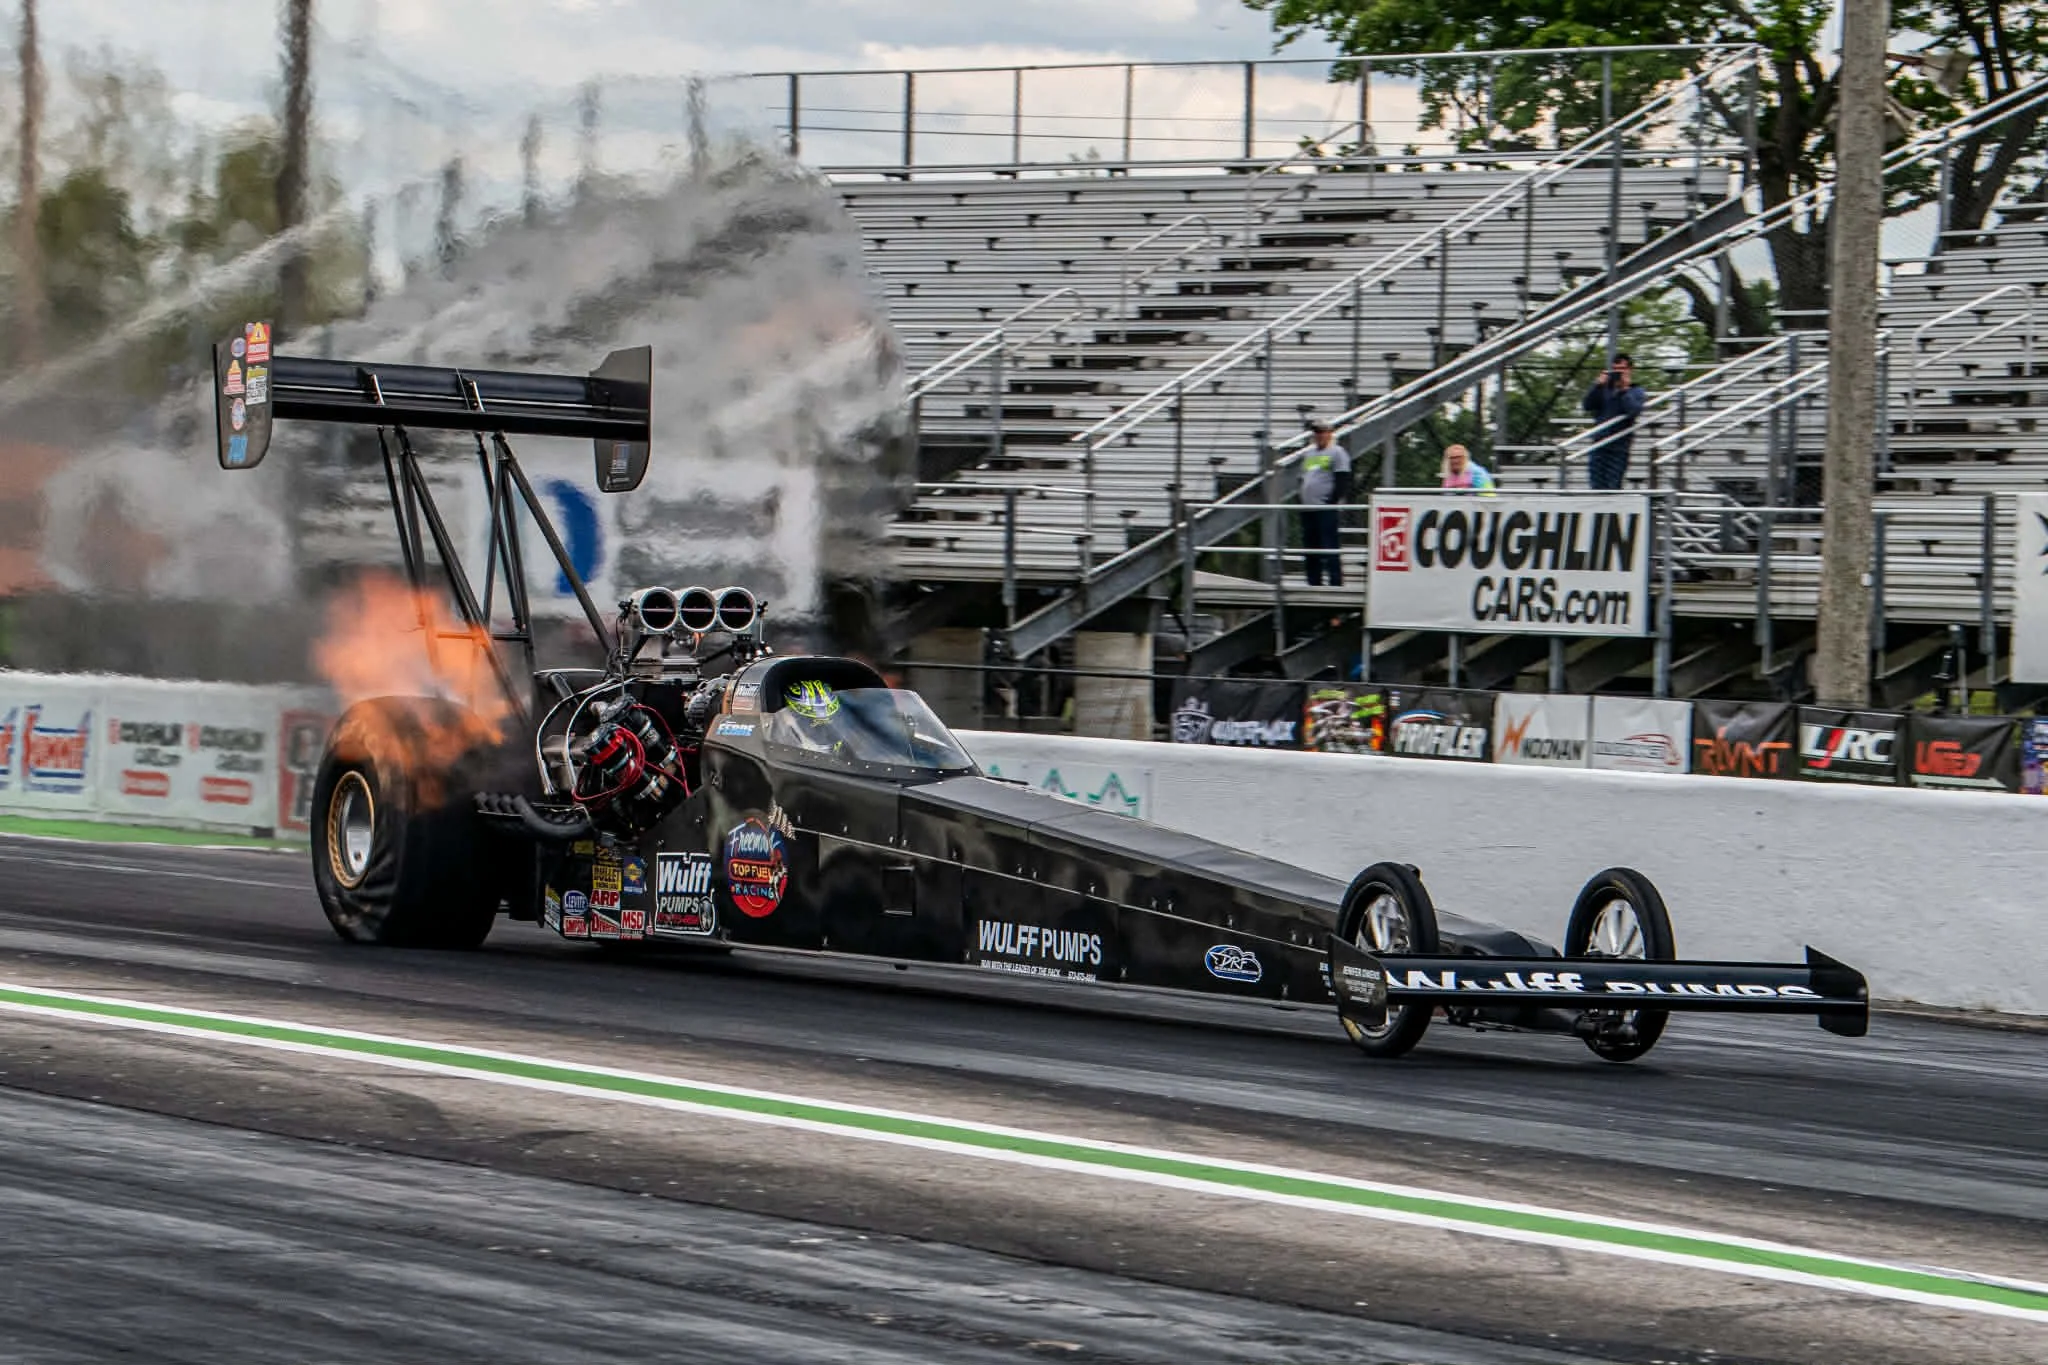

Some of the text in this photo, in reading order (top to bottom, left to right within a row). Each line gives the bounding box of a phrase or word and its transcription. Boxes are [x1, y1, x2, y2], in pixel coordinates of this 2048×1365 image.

[1415, 510, 1640, 571] COUGHLIN
[1472, 576, 1630, 624] CARS.com
[659, 861, 712, 893] Wulff
[732, 863, 751, 878] TOP
[591, 890, 619, 906] ARP
[734, 883, 774, 900] RACING
[660, 896, 699, 913] PUMPS
[622, 911, 643, 929] MSD
[979, 919, 1101, 965] WULFF PUMPS
